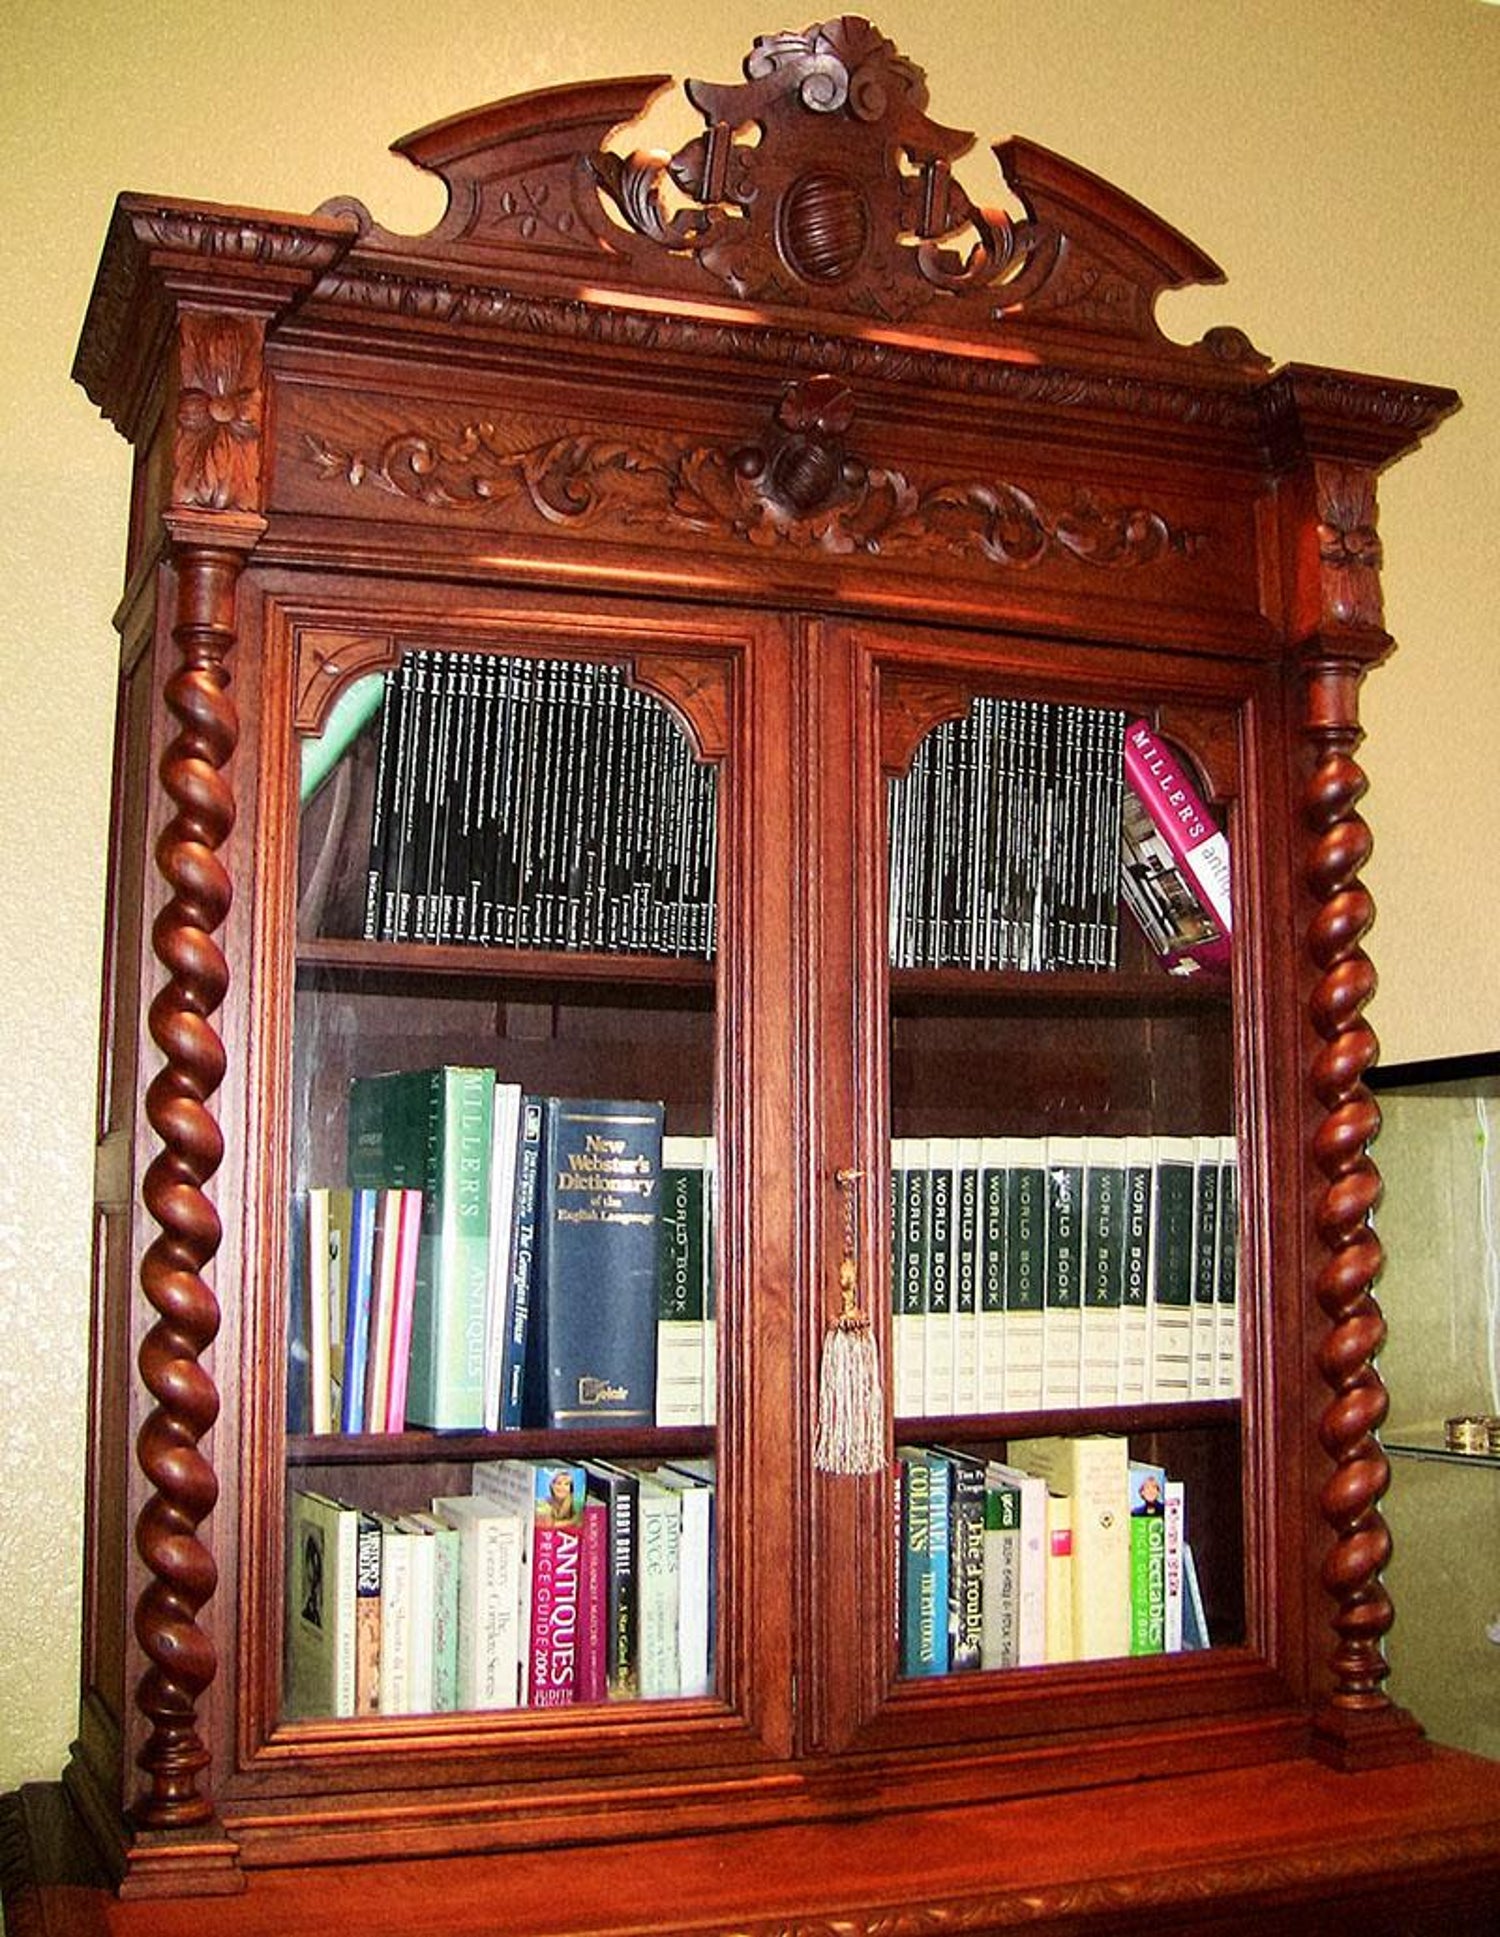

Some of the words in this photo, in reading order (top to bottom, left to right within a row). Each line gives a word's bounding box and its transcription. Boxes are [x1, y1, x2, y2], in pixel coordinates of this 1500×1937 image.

[1132, 730, 1205, 838] MILLER'S
[460, 1074, 484, 1217] MILLER'S
[567, 1154, 651, 1174] Webster's
[585, 1134, 627, 1154] New
[558, 1172, 655, 1197] Dictionary
[603, 1195, 622, 1208] the
[675, 1177, 688, 1245] WORLD
[909, 1177, 922, 1242] WORLD
[935, 1176, 947, 1241] WORLD
[963, 1175, 974, 1241] WORLD
[989, 1175, 1000, 1240] WORLD
[1020, 1175, 1031, 1239] WORLD
[1059, 1173, 1072, 1237] WORLD
[1100, 1175, 1111, 1237] WORLD
[1132, 1174, 1145, 1236] WORLD
[1203, 1174, 1215, 1233] WORLD
[519, 1223, 534, 1248] The
[512, 1250, 532, 1303] Georgian
[675, 1260, 688, 1312] BOOK
[909, 1254, 920, 1307] BOOK
[934, 1252, 946, 1306] BOOK
[961, 1252, 973, 1305] BOOK
[988, 1251, 999, 1304] BOOK
[1019, 1251, 1030, 1302] BOOK
[1058, 1248, 1070, 1300] BOOK
[1097, 1248, 1109, 1299] BOOK
[1130, 1247, 1142, 1299] BOOK
[1201, 1245, 1213, 1295] BOOK
[466, 1265, 487, 1378] ANTIQUES
[513, 1304, 529, 1345] House
[615, 1494, 631, 1535] RODDY
[909, 1466, 929, 1552] COLLINS
[929, 1466, 949, 1559] MICHAEL
[538, 1531, 553, 1582] PRICE
[615, 1539, 631, 1576] DOYLE
[643, 1510, 663, 1576] JOYCE
[967, 1517, 984, 1559] The
[551, 1531, 579, 1686] ANTIQUES
[1148, 1518, 1164, 1646] Collectables
[536, 1588, 551, 1646] GUIDE
[534, 1649, 548, 1686] 2004
